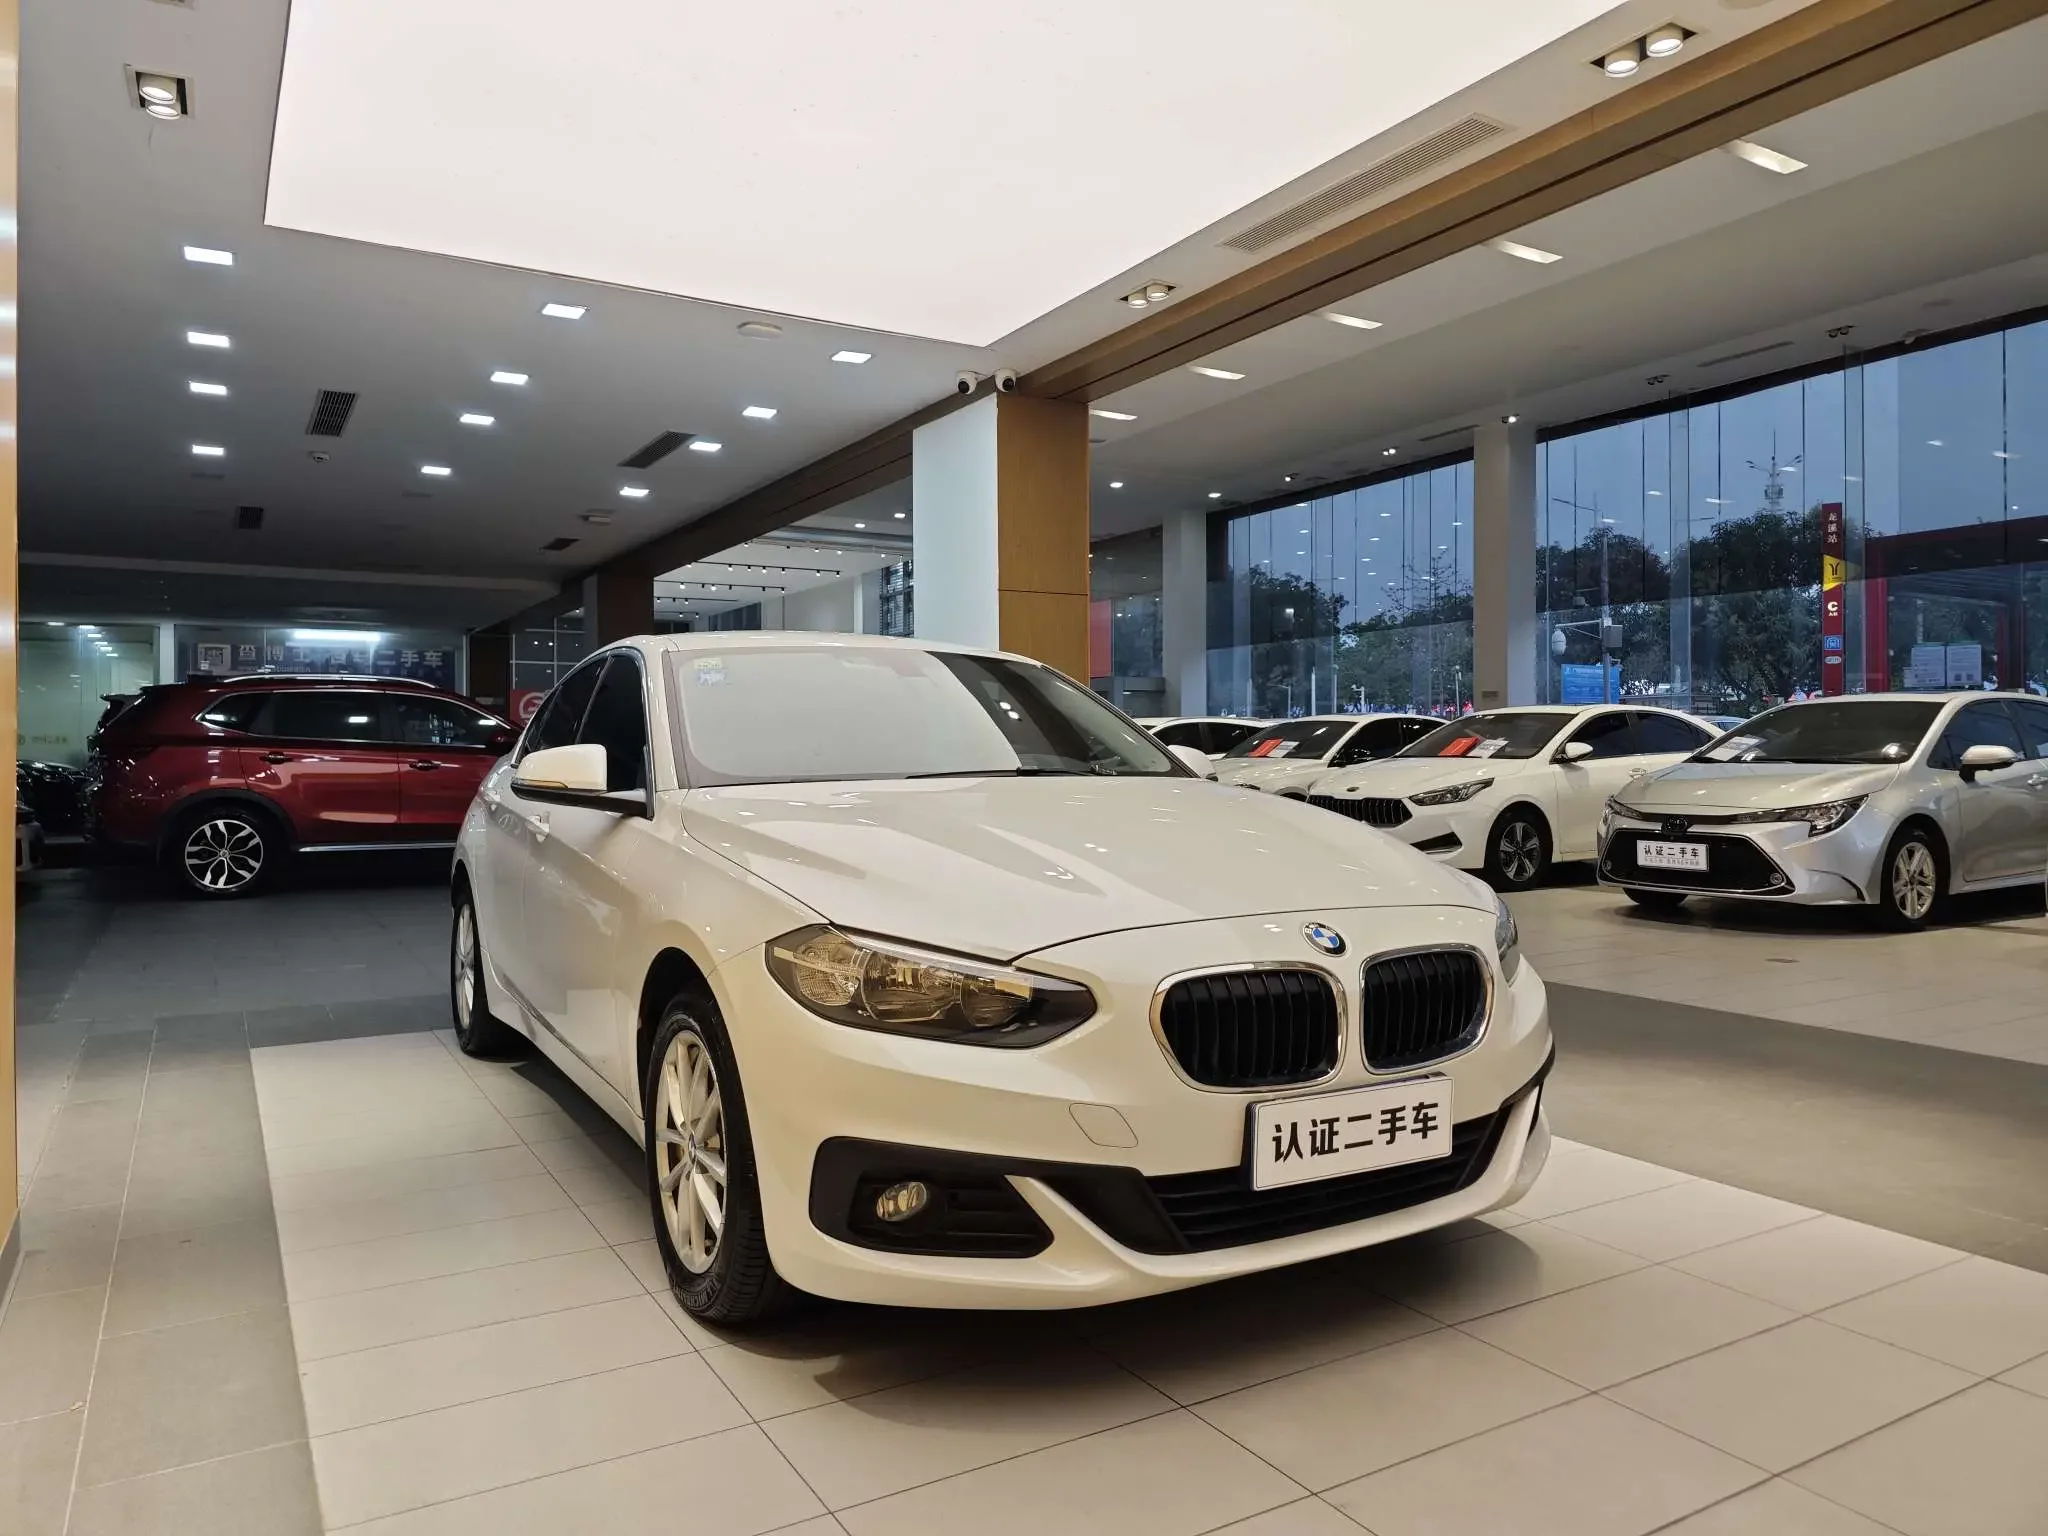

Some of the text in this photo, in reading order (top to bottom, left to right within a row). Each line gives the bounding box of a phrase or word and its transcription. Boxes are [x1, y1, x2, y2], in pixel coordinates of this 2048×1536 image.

[1827, 601, 1839, 612] C
[1643, 845, 1700, 858] 认证二手车
[1272, 1102, 1439, 1164] 认证二手车
